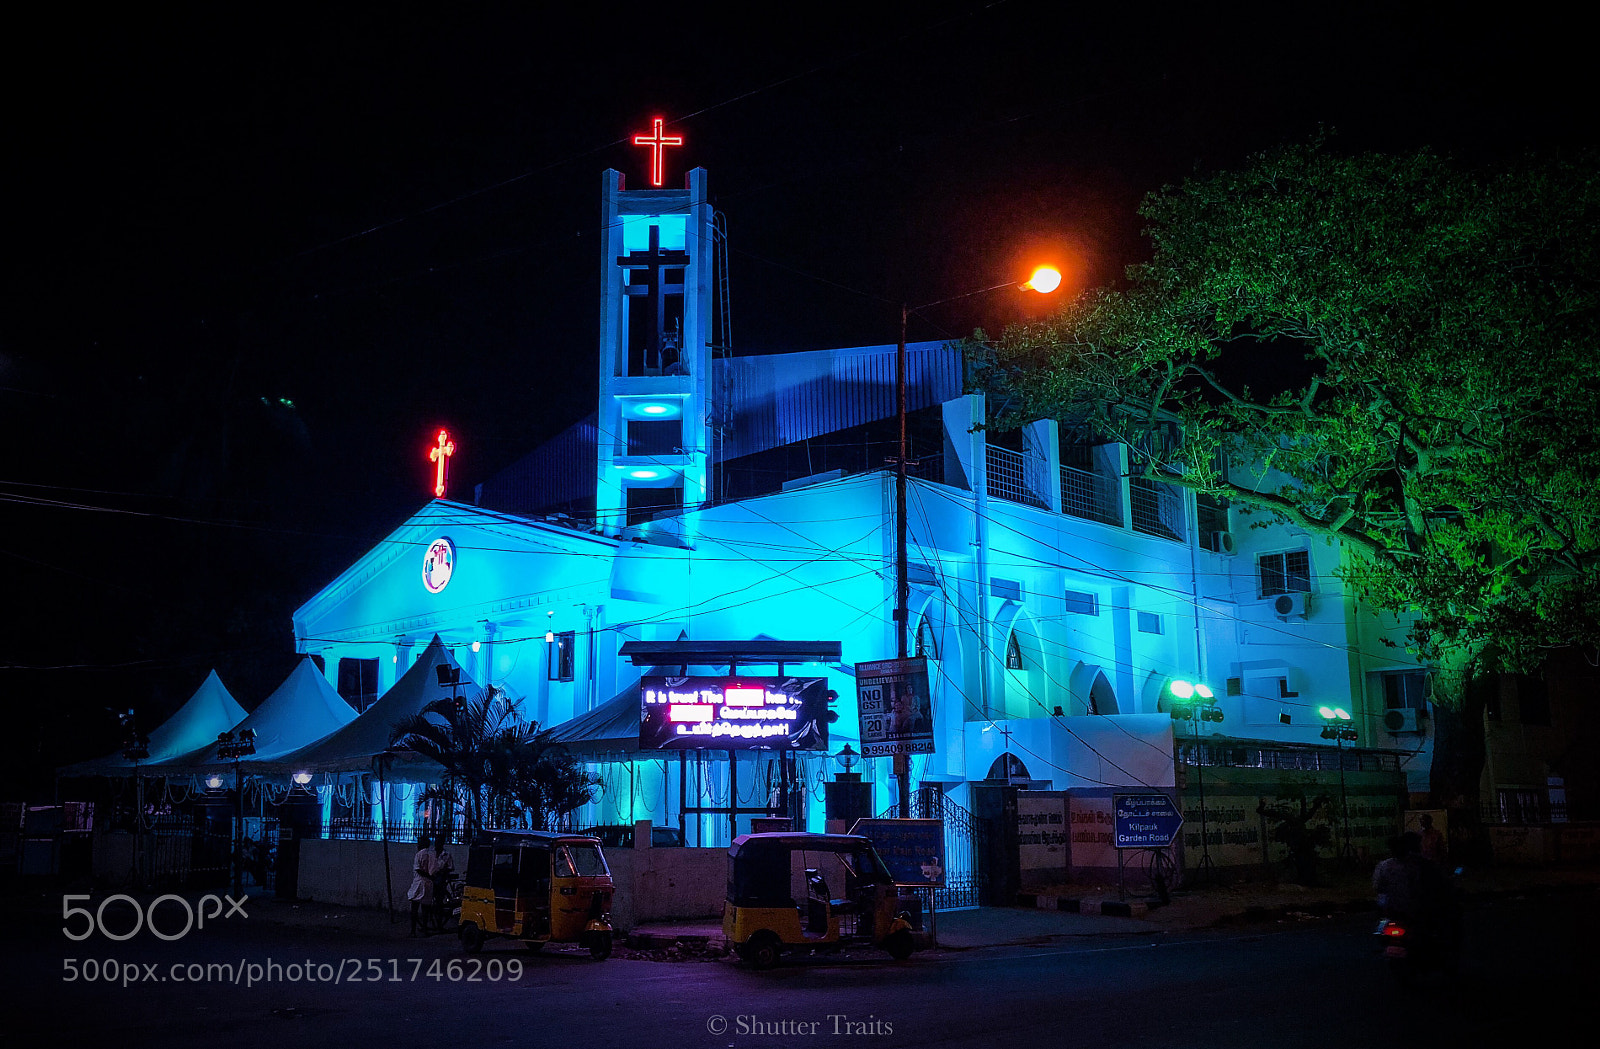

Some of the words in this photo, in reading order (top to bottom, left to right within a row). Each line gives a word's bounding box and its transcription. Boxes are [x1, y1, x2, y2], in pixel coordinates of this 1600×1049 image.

[701, 690, 723, 703] The
[766, 690, 786, 703] has
[862, 689, 881, 702] NO
[863, 701, 882, 710] GST
[872, 744, 903, 755] 99409
[905, 742, 932, 753] 88214
[1129, 823, 1158, 832] Kilpauk
[1119, 834, 1147, 842] Garden
[1149, 833, 1169, 842] Road
